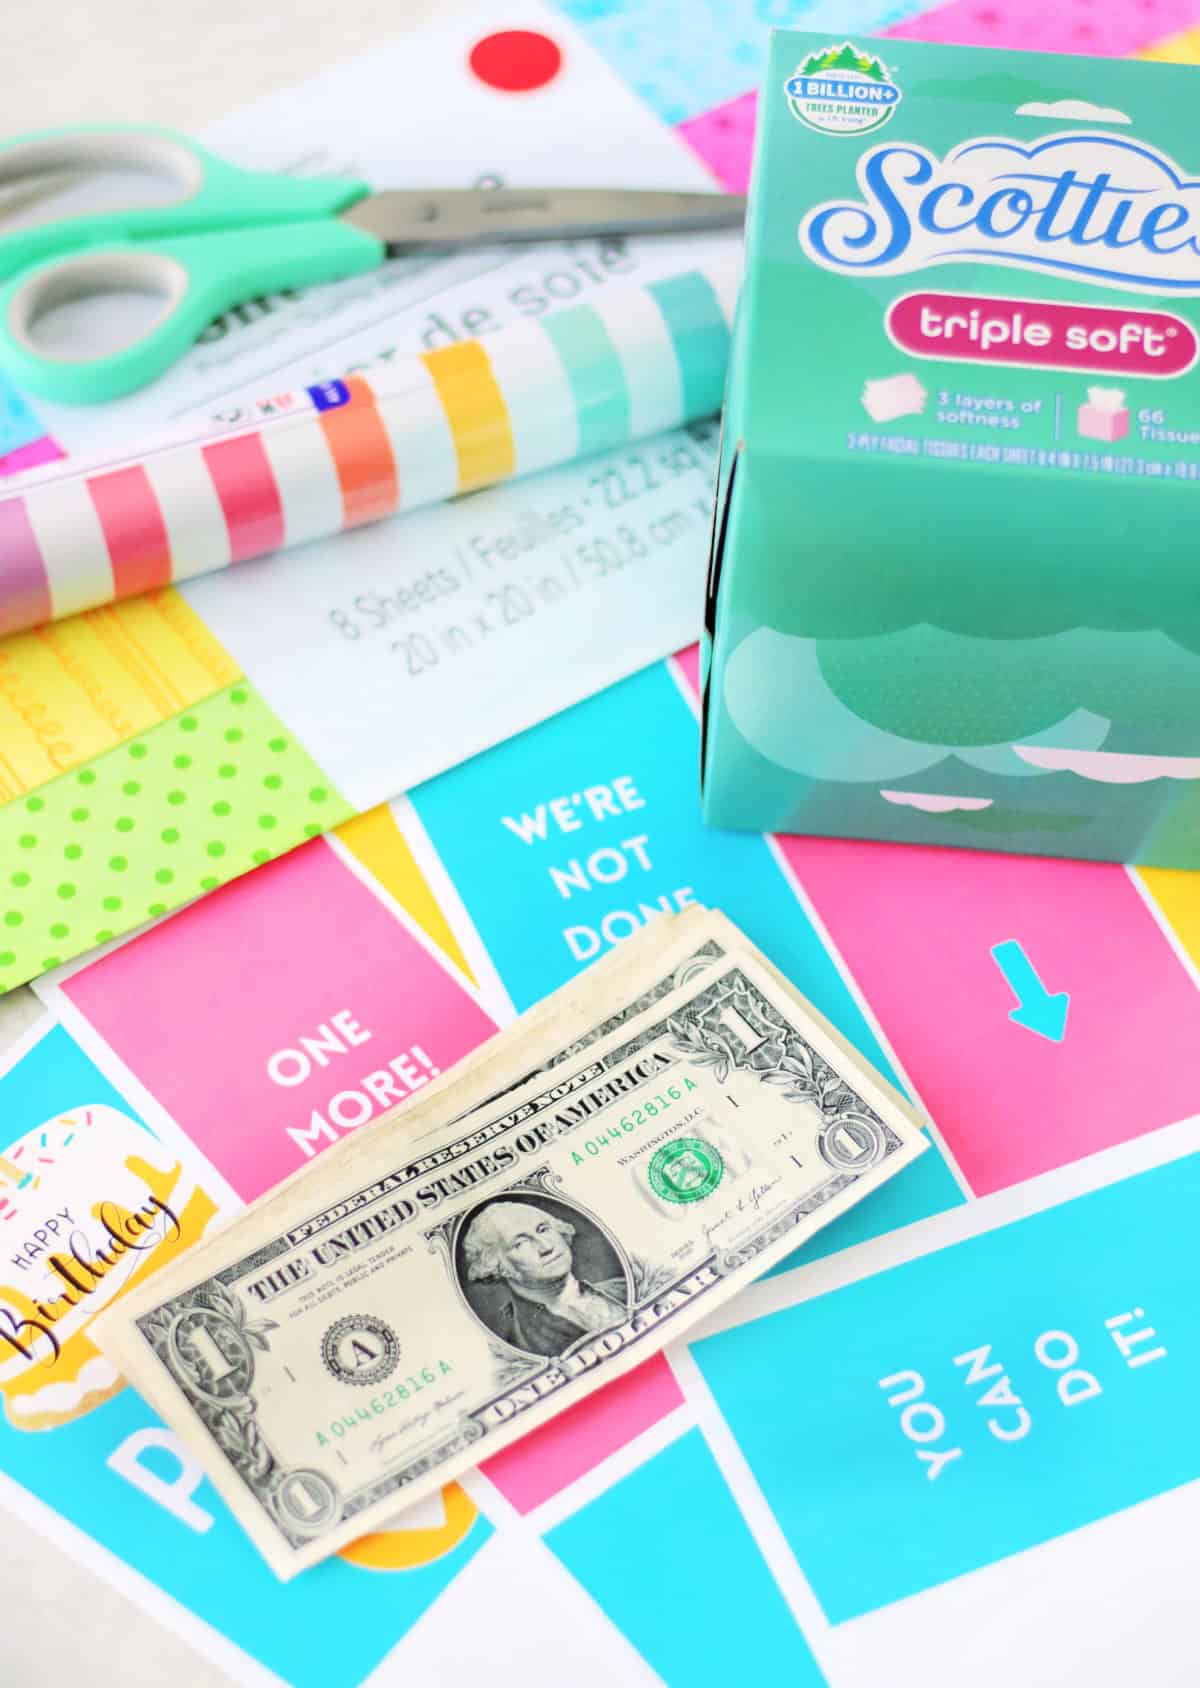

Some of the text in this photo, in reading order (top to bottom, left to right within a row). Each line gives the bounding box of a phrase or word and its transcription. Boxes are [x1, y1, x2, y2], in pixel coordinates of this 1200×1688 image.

[806, 83, 894, 101] BILLION+
[807, 147, 1200, 270] Scottie
[919, 306, 1051, 351] triple
[936, 391, 1042, 414] 3 layers of
[936, 410, 1020, 430] softness
[1137, 410, 1165, 425] 66
[329, 608, 361, 641] 8
[353, 567, 462, 629] Sheets
[468, 503, 586, 567] Feuilles
[391, 632, 440, 677] 20
[442, 622, 473, 653] in
[487, 582, 536, 627] 20
[533, 571, 566, 601] in
[576, 527, 649, 578] 50.8
[501, 775, 647, 846] WE'RE
[548, 836, 654, 900] NOT
[266, 1008, 373, 1088] ONE
[719, 1005, 770, 1055] 1
[285, 1045, 441, 1159] MORE!
[248, 1052, 673, 1302] THE UNITED STATES OF AMERICA
[291, 1063, 605, 1242] FEDERAL RESERVE NOTE
[835, 1128, 870, 1160] 1
[10, 1207, 76, 1271] HAPPY
[0, 1195, 181, 1368] Birthday
[187, 1325, 240, 1382] 1
[351, 1338, 378, 1369] A
[486, 1266, 724, 1421] ONE DOLLAR
[1033, 1329, 1103, 1408] DO
[1103, 1306, 1168, 1369] IT!
[878, 1368, 963, 1482] YOU
[952, 1343, 1032, 1442] CAN
[288, 1480, 327, 1518] 1
